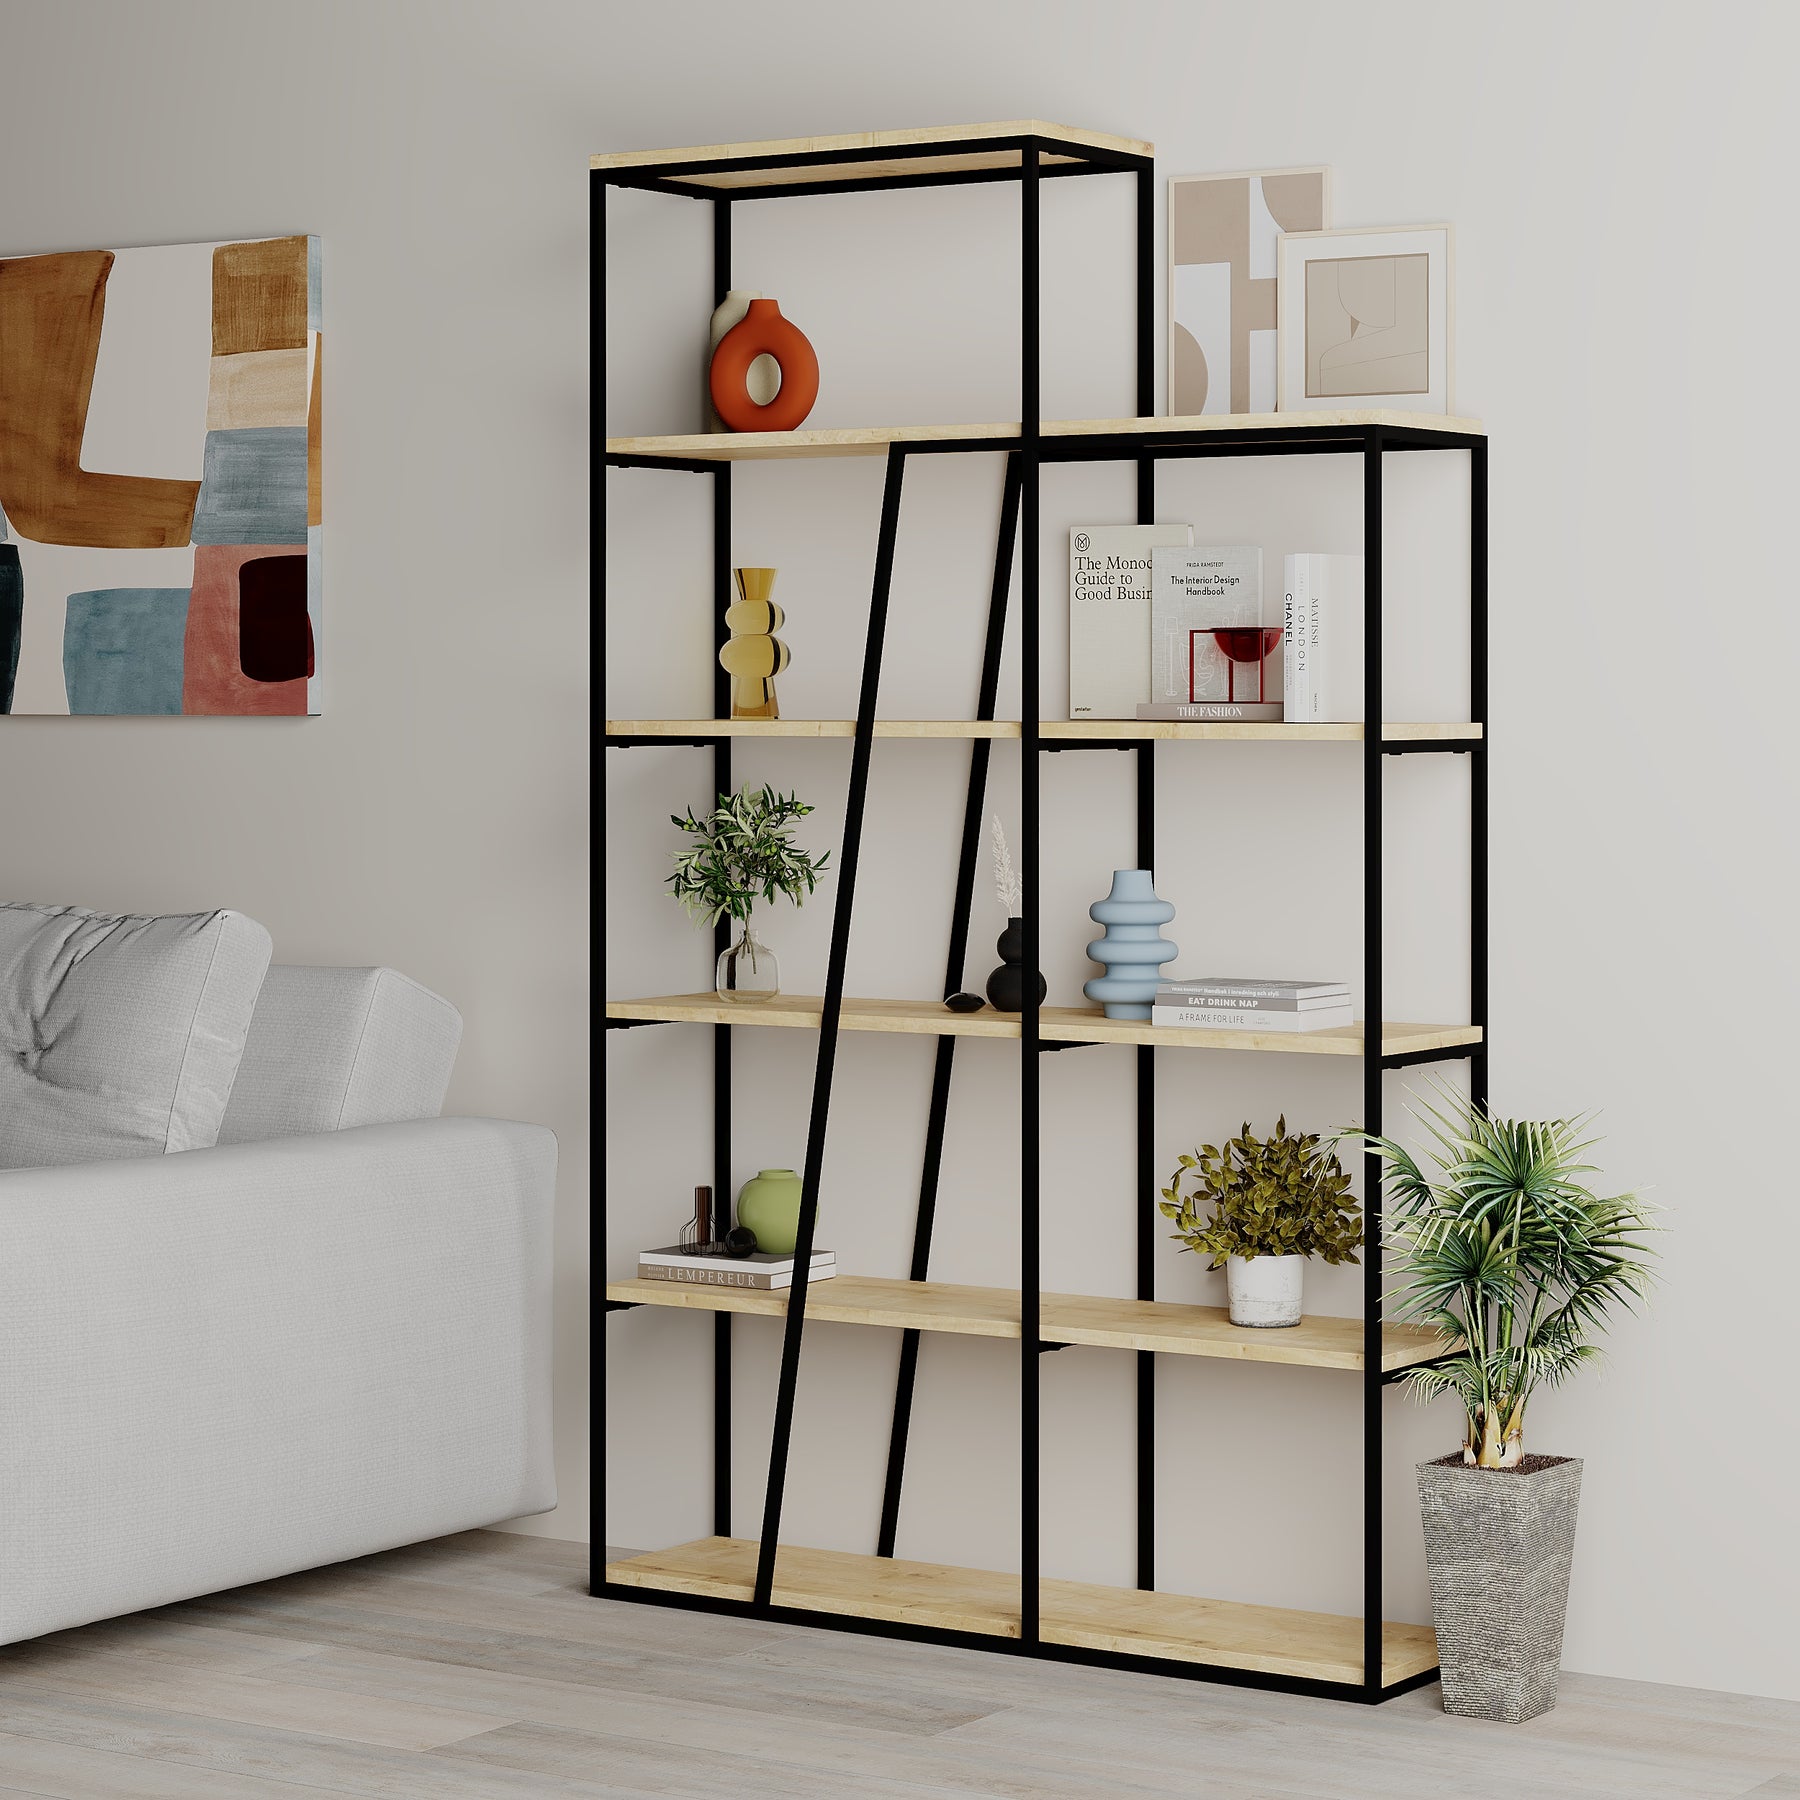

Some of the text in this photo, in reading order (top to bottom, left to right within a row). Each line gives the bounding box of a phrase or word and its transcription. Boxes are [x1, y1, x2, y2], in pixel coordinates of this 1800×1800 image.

[1075, 556, 1102, 570] The
[1075, 571, 1133, 585] Guide to
[1171, 575, 1240, 586] The Interior Design
[1075, 586, 1112, 601] Good
[1186, 587, 1225, 596] Handbook
[1285, 593, 1293, 646] CHANEL
[1311, 598, 1319, 648] MATISSE
[1298, 605, 1306, 671] LONDON
[1177, 706, 1242, 717] THE FASHION
[1188, 997, 1259, 1008] EAT DRINK NAP
[1179, 1013, 1184, 1021] A
[1185, 1013, 1211, 1023] FRAME
[1213, 1014, 1228, 1023] FOR
[1229, 1015, 1245, 1024] LIFE
[668, 1267, 756, 1287] LEMPEREUR
